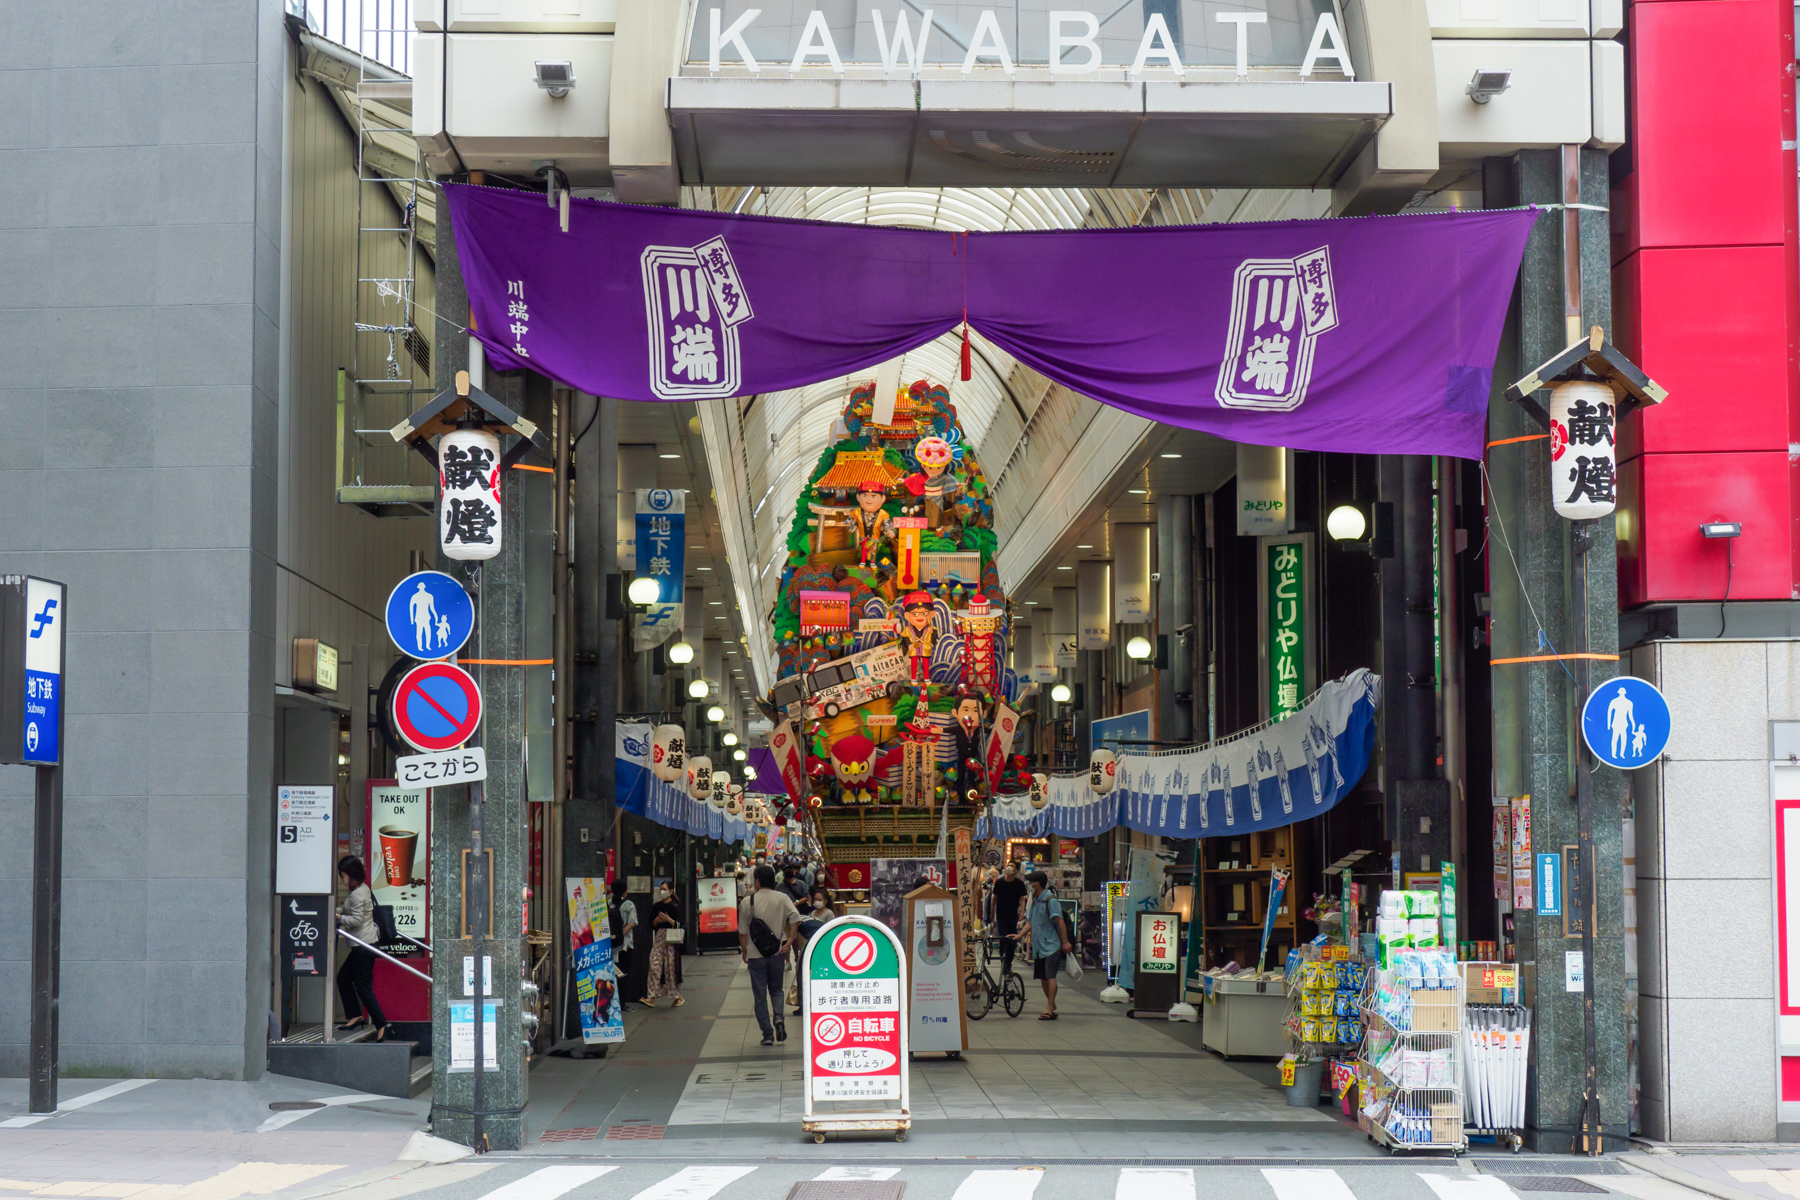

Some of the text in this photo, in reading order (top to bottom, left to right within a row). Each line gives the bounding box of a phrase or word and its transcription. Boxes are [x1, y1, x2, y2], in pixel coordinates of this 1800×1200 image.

[709, 7, 1357, 77] KAWABATA
[701, 246, 740, 319] 博多
[1299, 257, 1330, 328] 博多
[666, 266, 718, 383] 川端
[1242, 277, 1298, 395] 川端
[443, 444, 498, 544] 献燈
[1243, 500, 1283, 511] みどりや
[649, 516, 671, 576] 地下鉄
[27, 676, 53, 700] 地下鉄
[820, 686, 840, 697] KBC
[27, 702, 46, 717] Subway
[404, 756, 479, 782] ここから
[380, 794, 420, 803] TAKE OUT
[393, 806, 405, 814] OK
[284, 826, 295, 843] 5
[385, 846, 395, 878] veloce
[390, 943, 417, 951] veloce
[1152, 919, 1167, 959] お仏壇
[830, 981, 880, 989] 諸車通行止め
[818, 995, 893, 1006] 歩行者専用道路
[848, 1017, 895, 1034] 自転車
[843, 1050, 869, 1058] 押して
[828, 1060, 884, 1069] 通りましょう!
